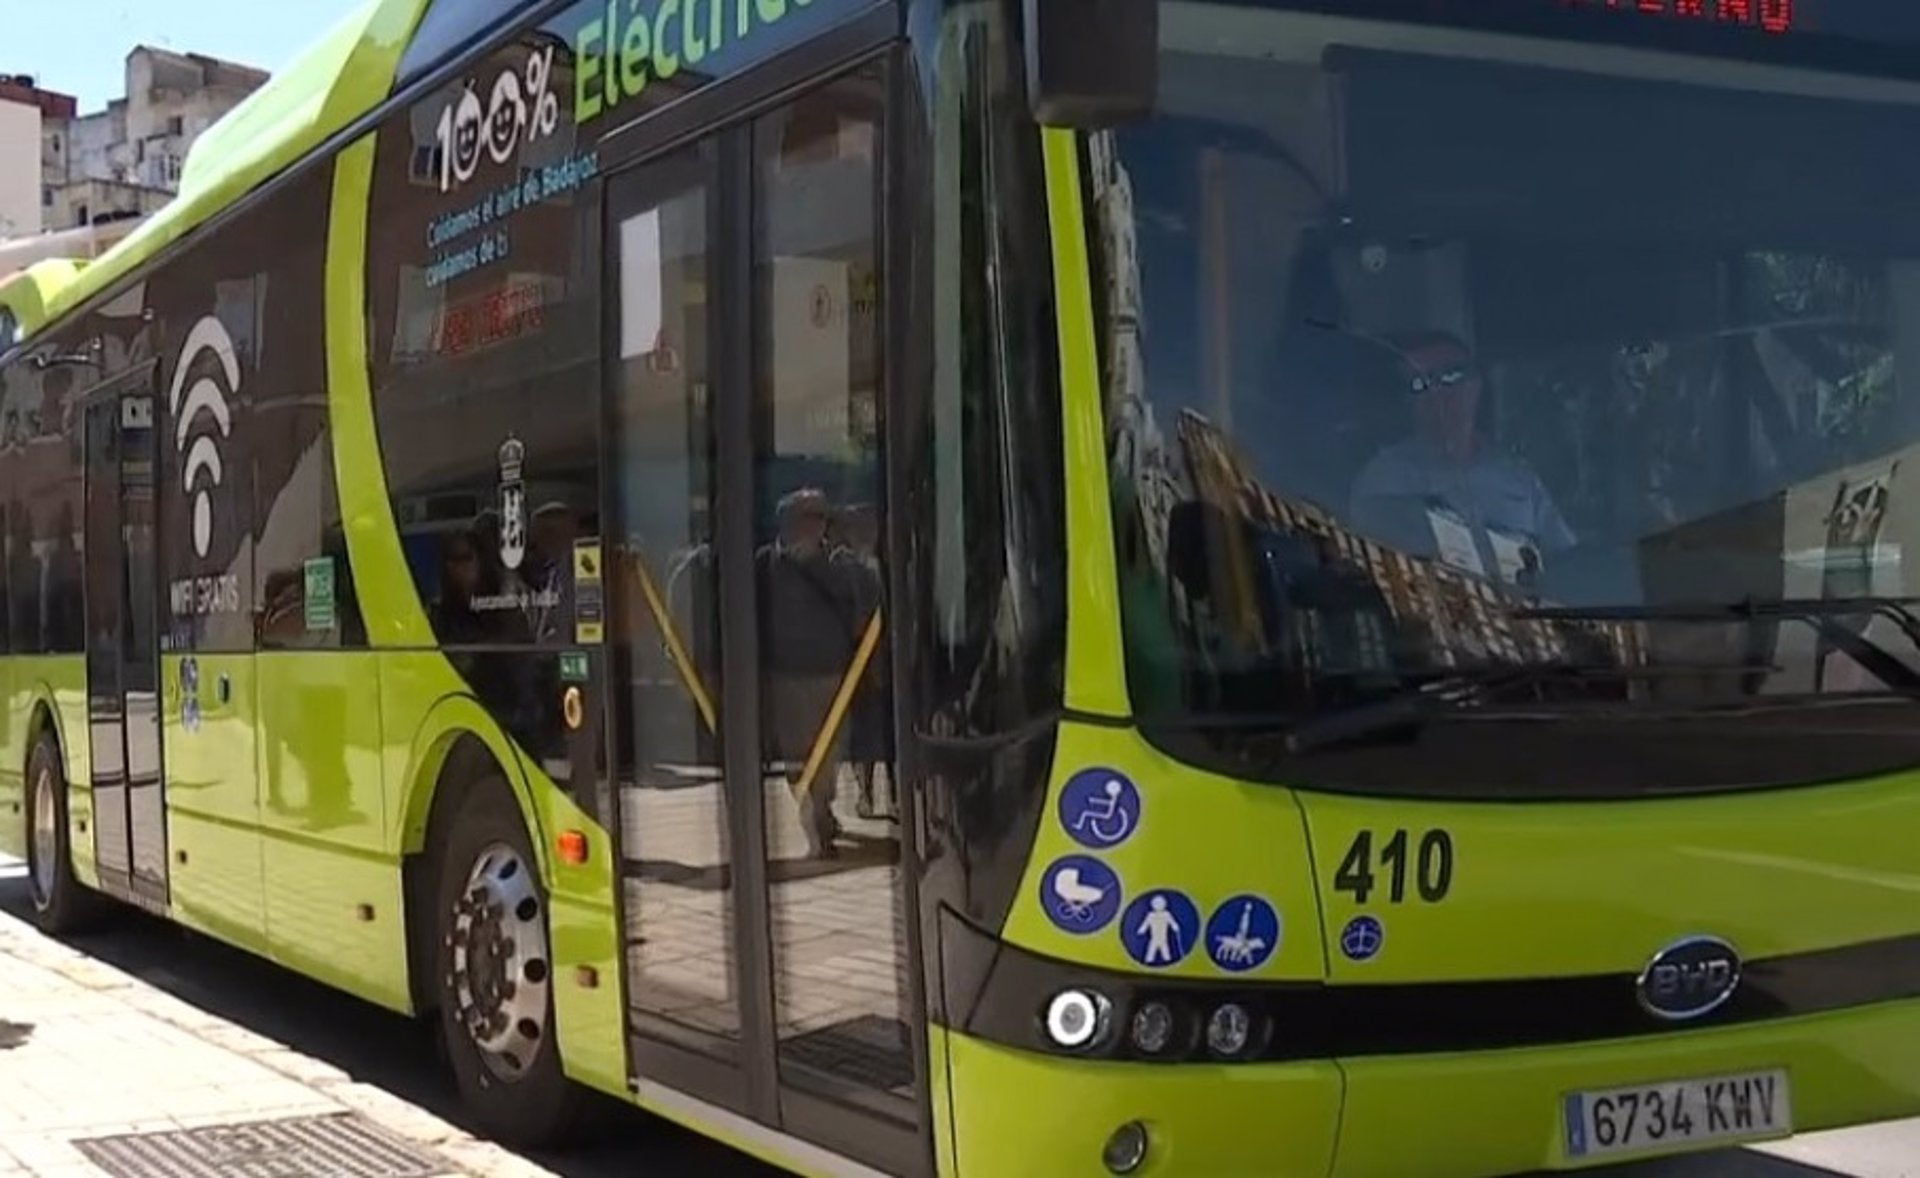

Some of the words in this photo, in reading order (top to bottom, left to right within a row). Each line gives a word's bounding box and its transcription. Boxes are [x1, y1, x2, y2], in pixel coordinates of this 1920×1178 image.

[436, 45, 558, 193] 100%
[1335, 828, 1454, 904] 410
[1654, 960, 1729, 994] BYD
[1593, 1087, 1692, 1147] 6734
[1704, 1076, 1775, 1133] KWV
